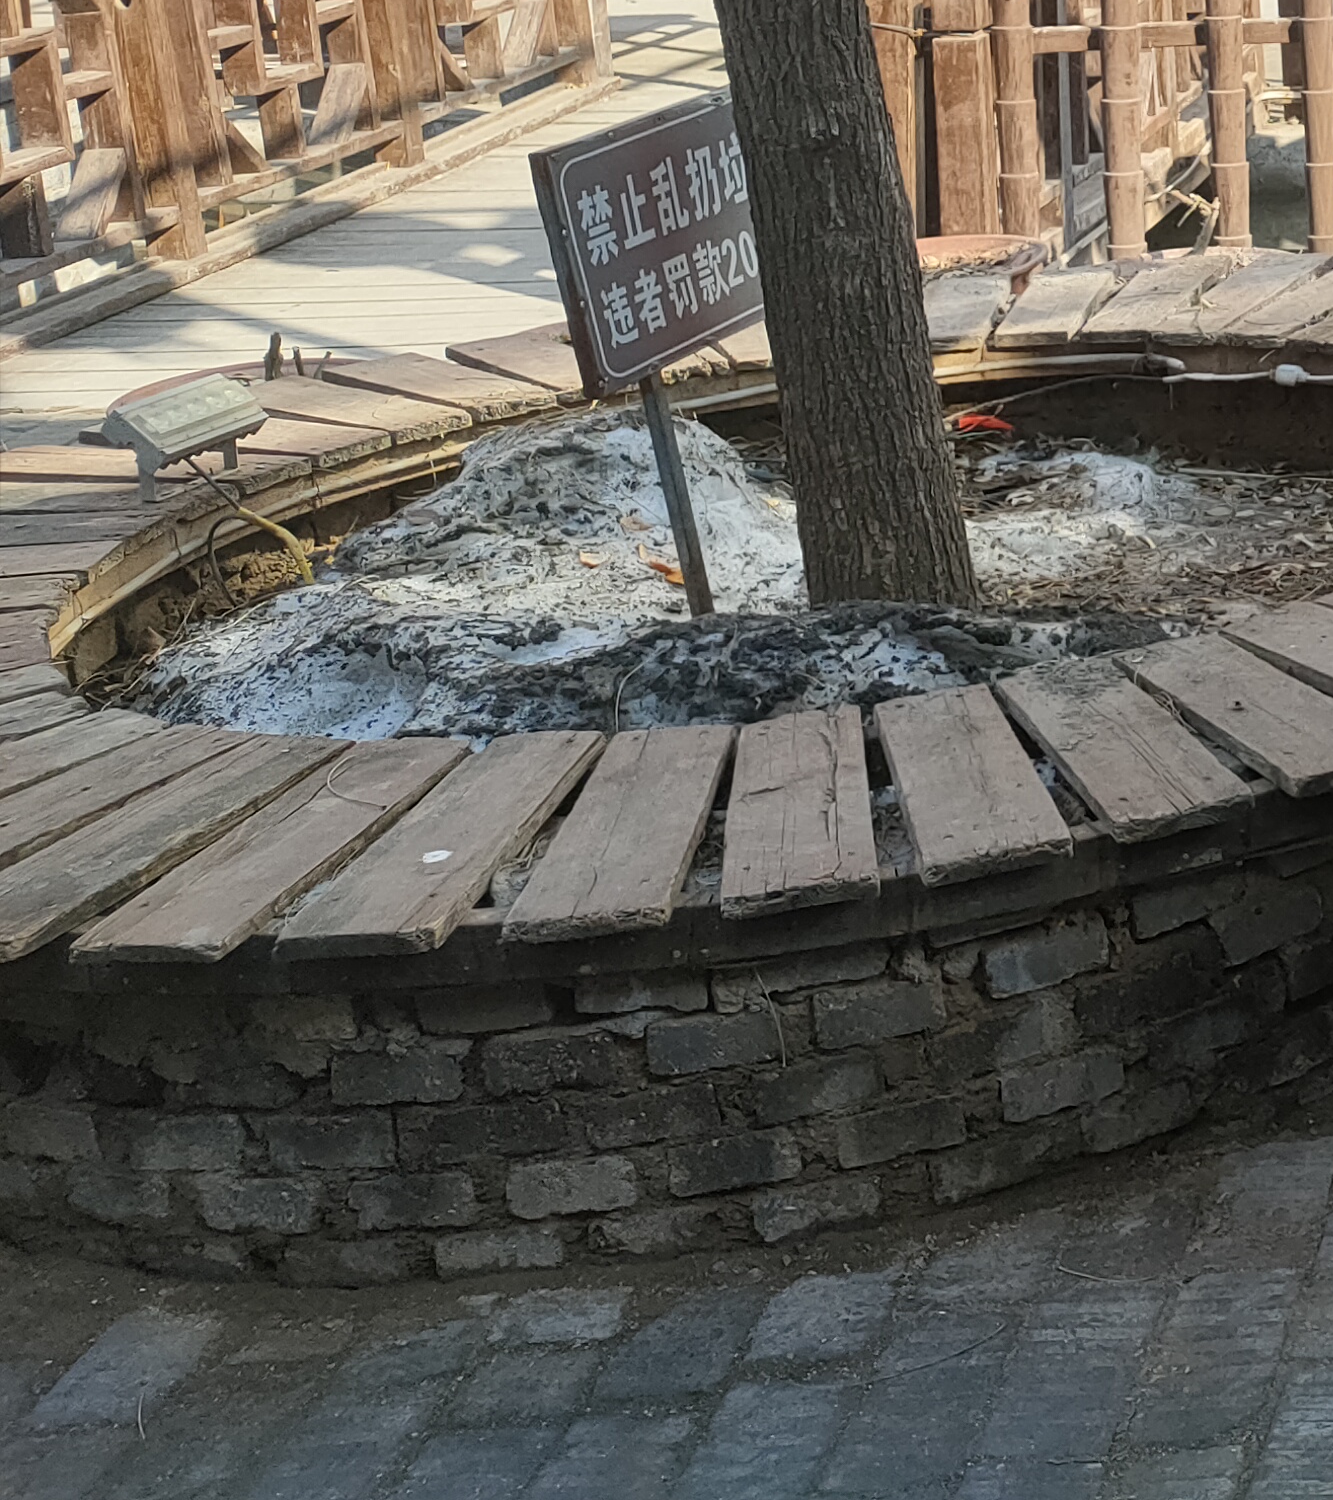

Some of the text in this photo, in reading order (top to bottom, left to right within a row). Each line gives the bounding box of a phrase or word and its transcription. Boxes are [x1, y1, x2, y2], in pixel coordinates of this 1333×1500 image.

[577, 131, 749, 266] 禁止乱扔垃
